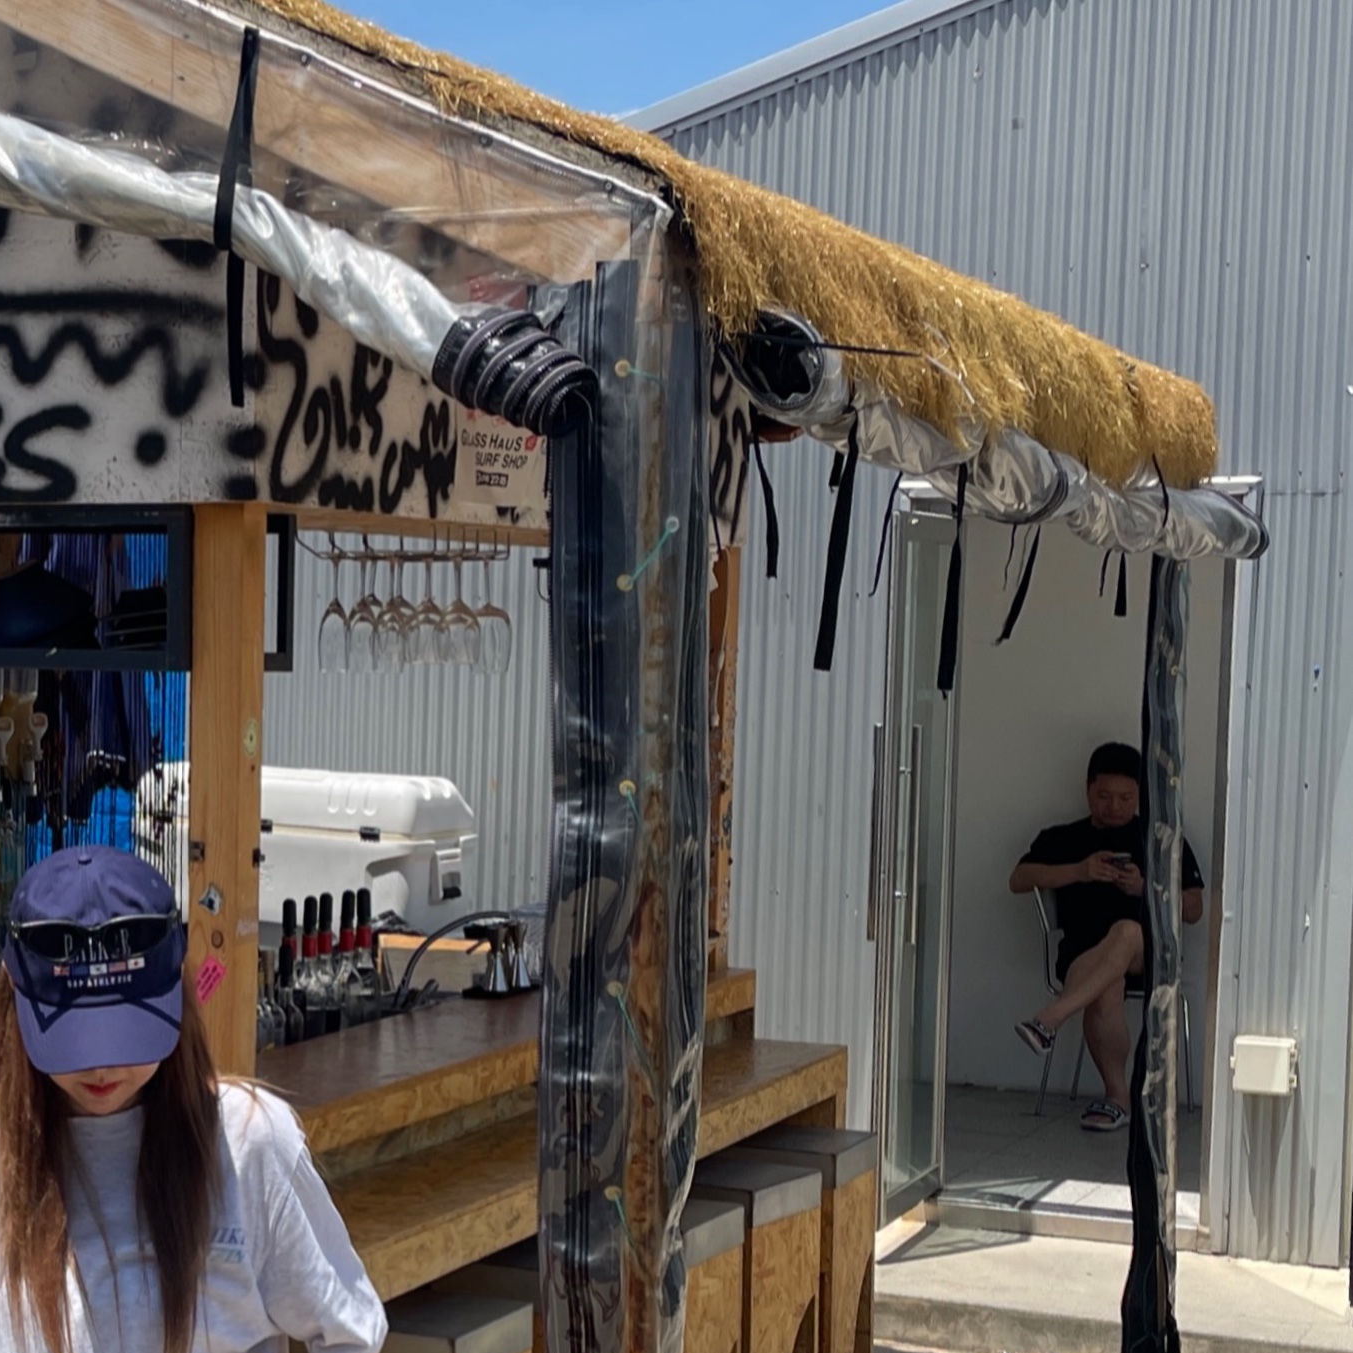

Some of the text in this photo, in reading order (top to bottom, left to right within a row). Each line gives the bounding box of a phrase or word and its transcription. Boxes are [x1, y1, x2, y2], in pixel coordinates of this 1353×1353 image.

[489, 433, 524, 452] HAUS
[475, 451, 529, 470] SURF SHOP
